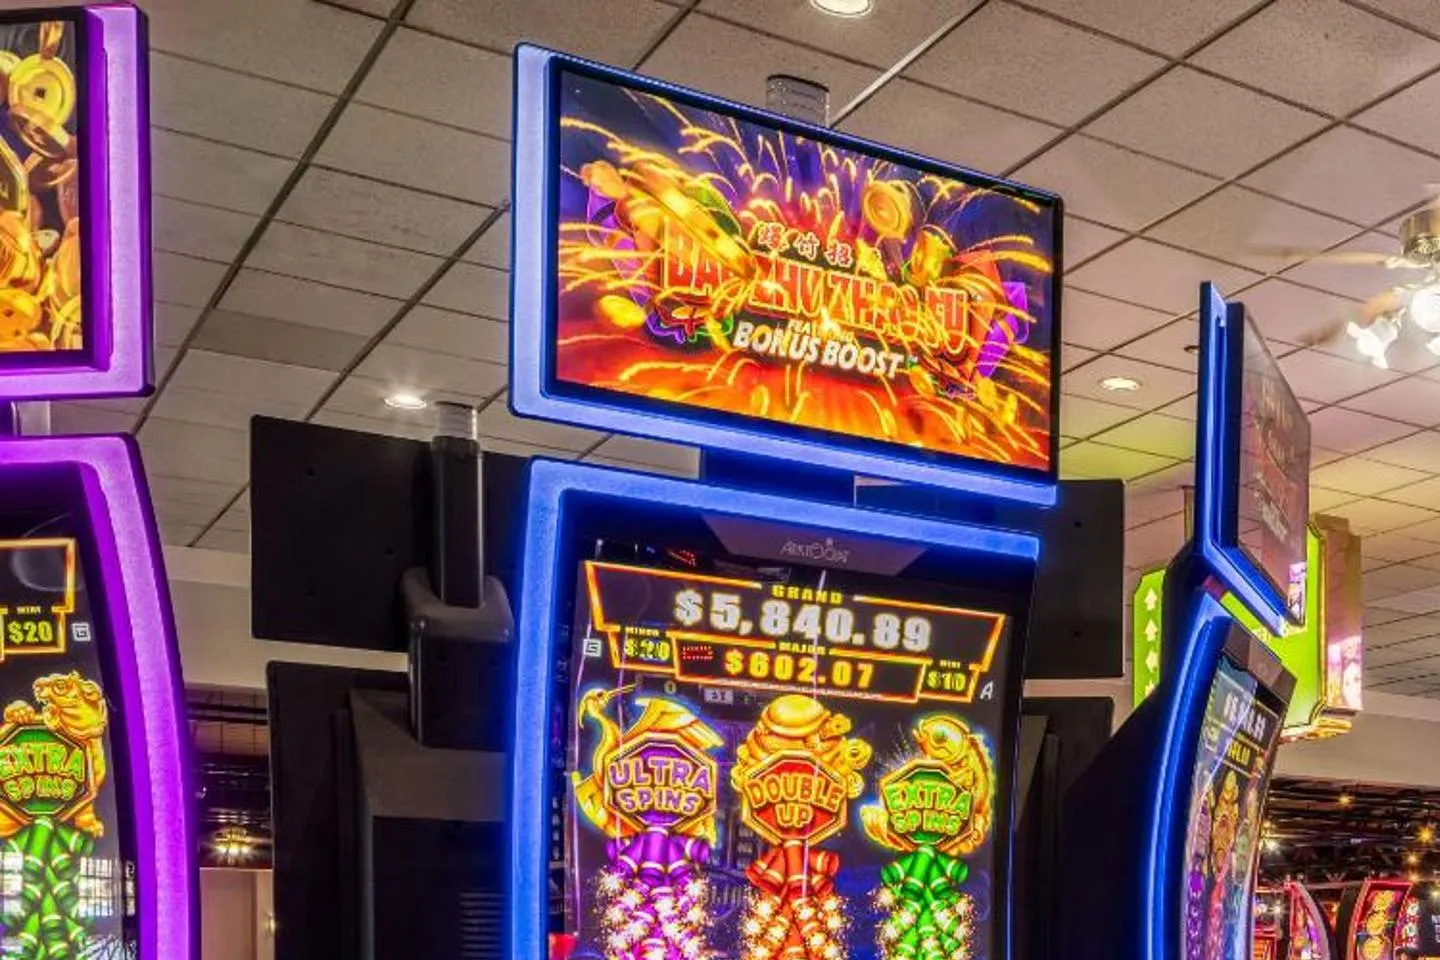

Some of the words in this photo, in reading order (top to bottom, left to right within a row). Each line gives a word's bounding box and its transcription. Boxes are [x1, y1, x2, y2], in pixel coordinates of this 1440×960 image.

[734, 321, 820, 363] BONUS
[821, 333, 903, 379] BOOST
[772, 584, 843, 605] GRAND
[8, 621, 53, 645] $20
[675, 588, 931, 651] $5,840.89
[724, 651, 874, 688] $602.07
[4, 775, 79, 802] SPINS
[608, 756, 712, 798] ULTRA
[746, 773, 848, 813] DOUBLE
[618, 788, 702, 816] SPINS
[775, 802, 814, 830] UP
[883, 782, 970, 818] EXTRA
[892, 806, 962, 834] SPINS
